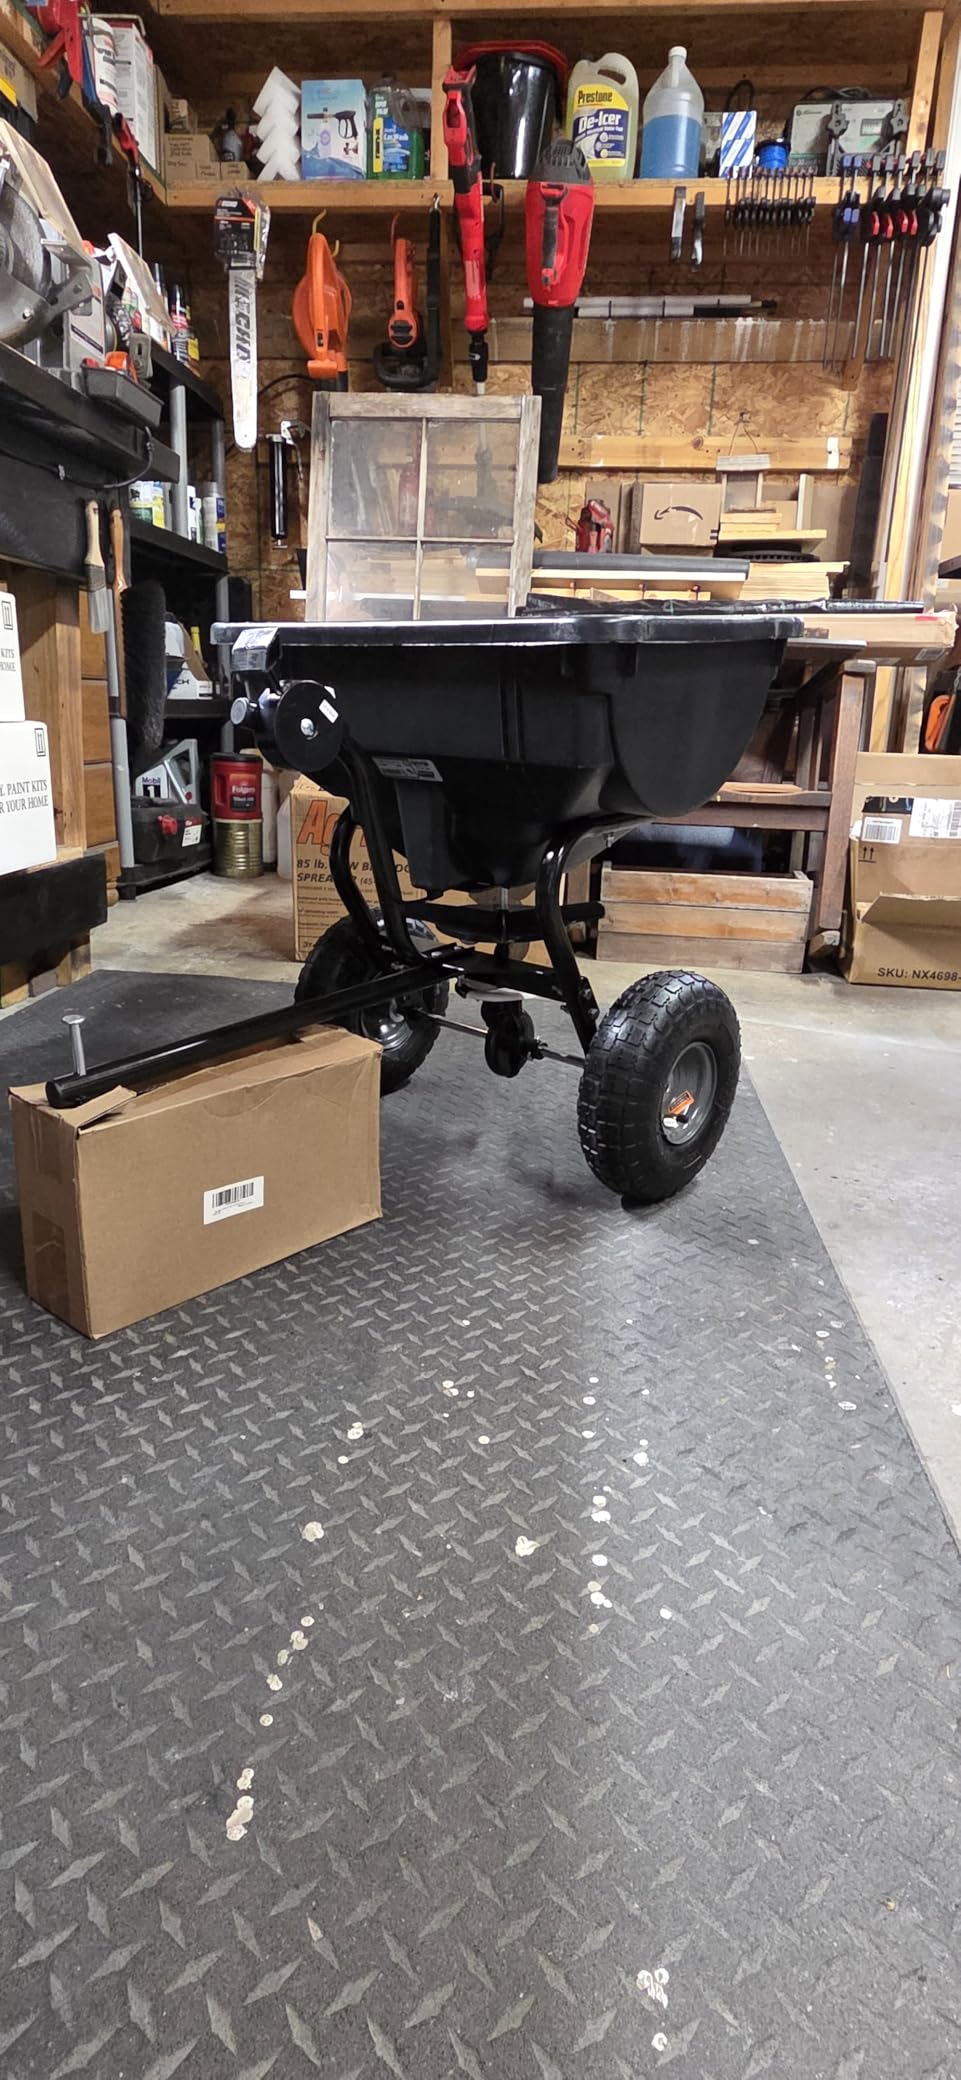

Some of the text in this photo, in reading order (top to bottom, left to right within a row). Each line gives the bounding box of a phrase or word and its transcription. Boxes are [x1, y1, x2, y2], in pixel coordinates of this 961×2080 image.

[578, 90, 613, 105] Prestone
[578, 111, 622, 134] De-Icer
[6, 780, 30, 796] PAINT
[31, 779, 48, 793] KITS
[142, 777, 161, 785] Mobil
[5, 798, 28, 813] YOUR
[28, 795, 49, 809] HOME
[296, 859, 328, 869] 85 lb.
[877, 967, 908, 979] SKU:
